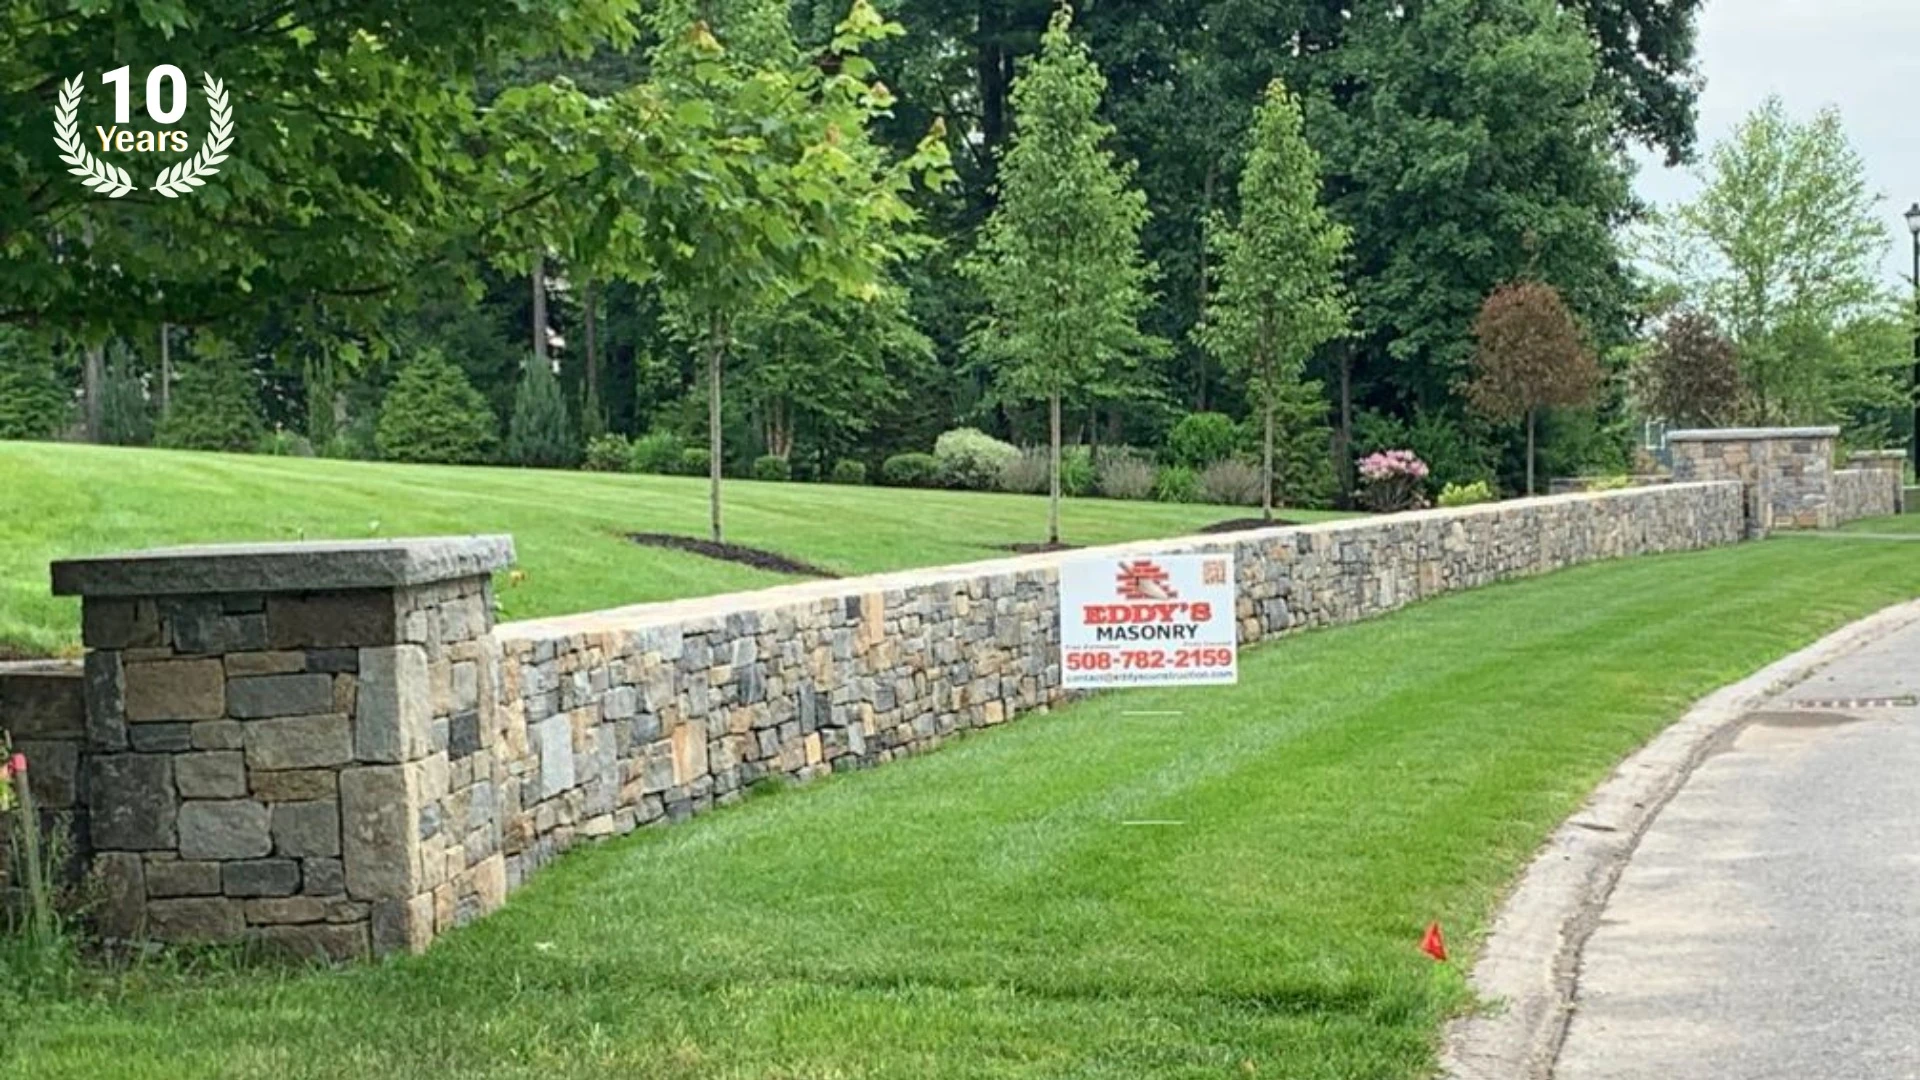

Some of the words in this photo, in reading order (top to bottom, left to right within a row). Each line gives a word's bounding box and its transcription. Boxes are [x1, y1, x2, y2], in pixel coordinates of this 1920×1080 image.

[1083, 602, 1212, 624] EDDY'S
[1096, 624, 1199, 641] MASONRY
[1066, 648, 1233, 671] 508-782-2159
